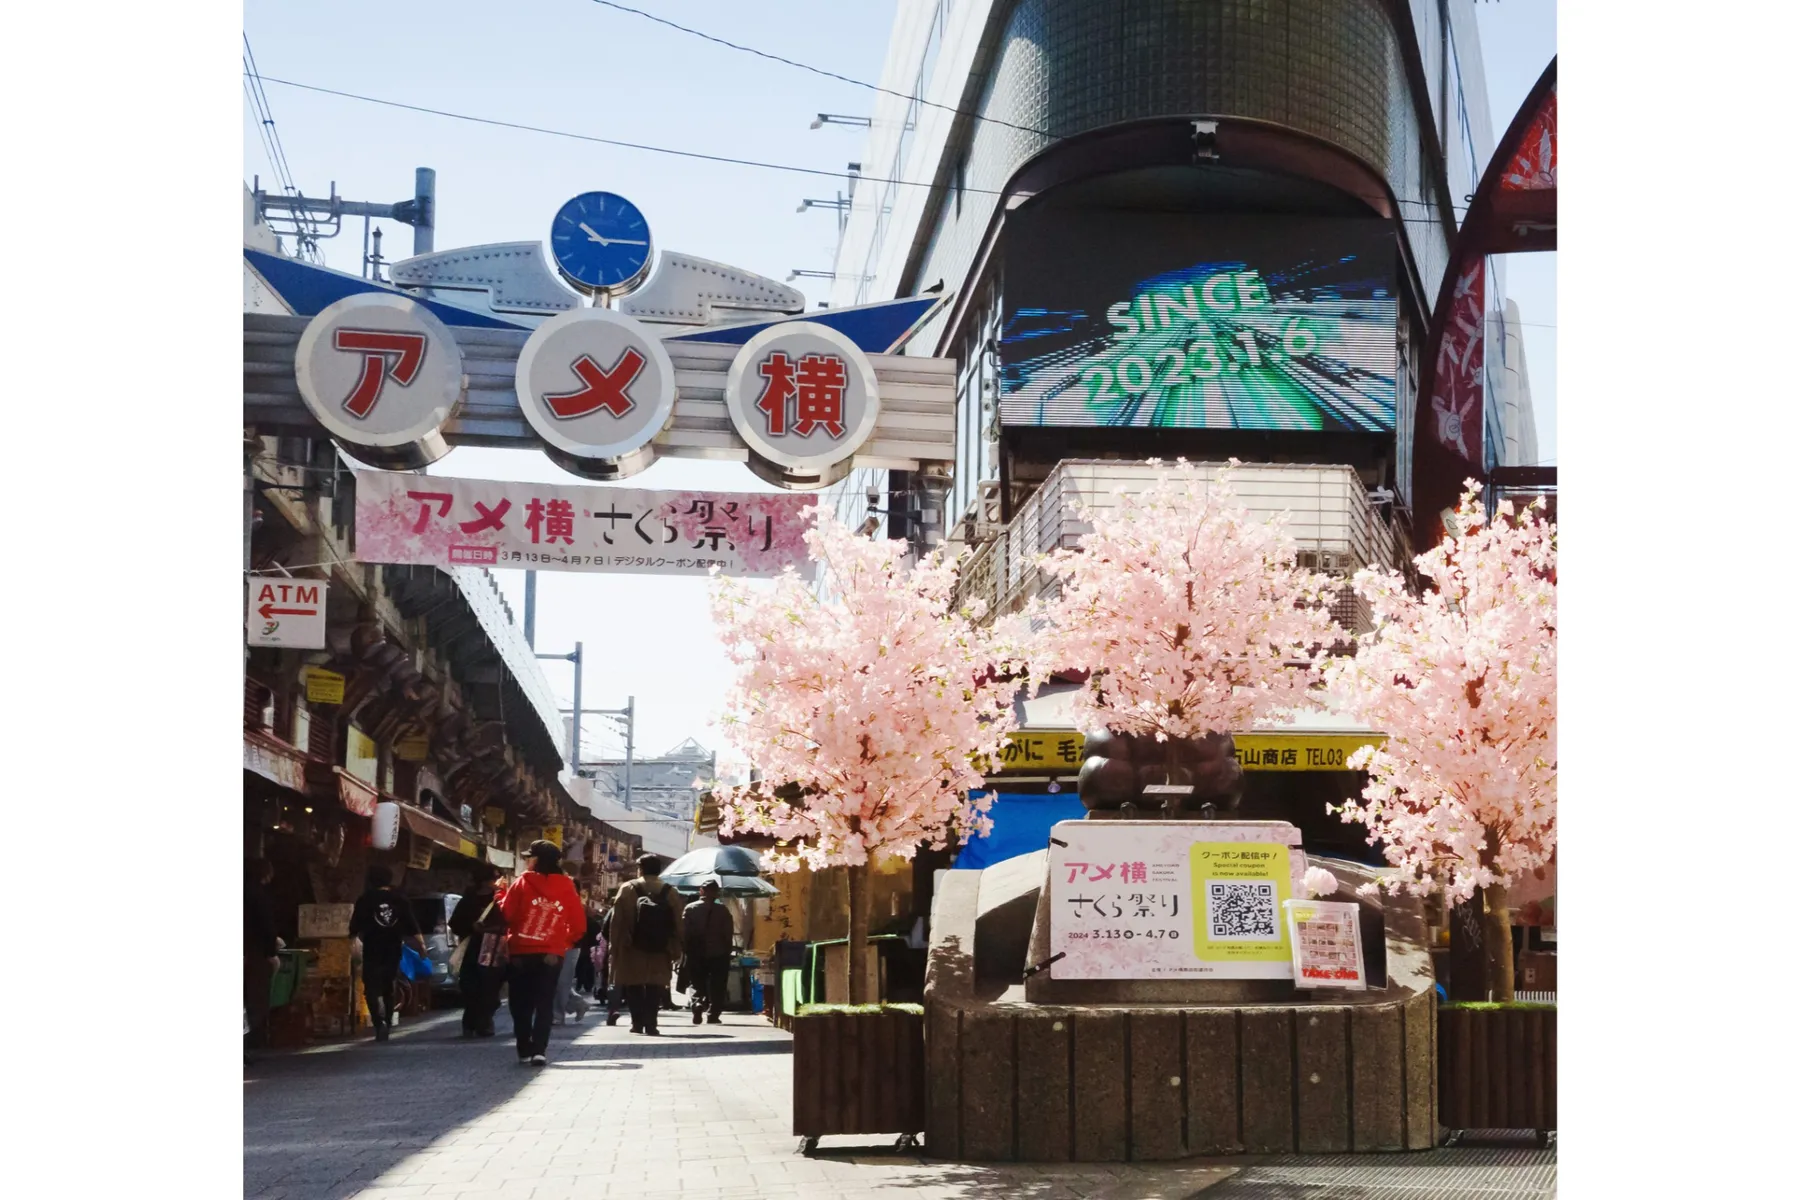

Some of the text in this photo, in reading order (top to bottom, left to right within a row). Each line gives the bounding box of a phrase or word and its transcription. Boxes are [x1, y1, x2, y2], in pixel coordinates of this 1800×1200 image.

[1107, 270, 1264, 341] SINCE
[333, 327, 848, 439] アメ横
[1082, 316, 1318, 404] 2023.1.6
[407, 490, 772, 551] アメ横 さくら祭り
[258, 584, 318, 604] ATM
[1064, 861, 1147, 884] アメ横
[1067, 893, 1178, 918] さくら祭り
